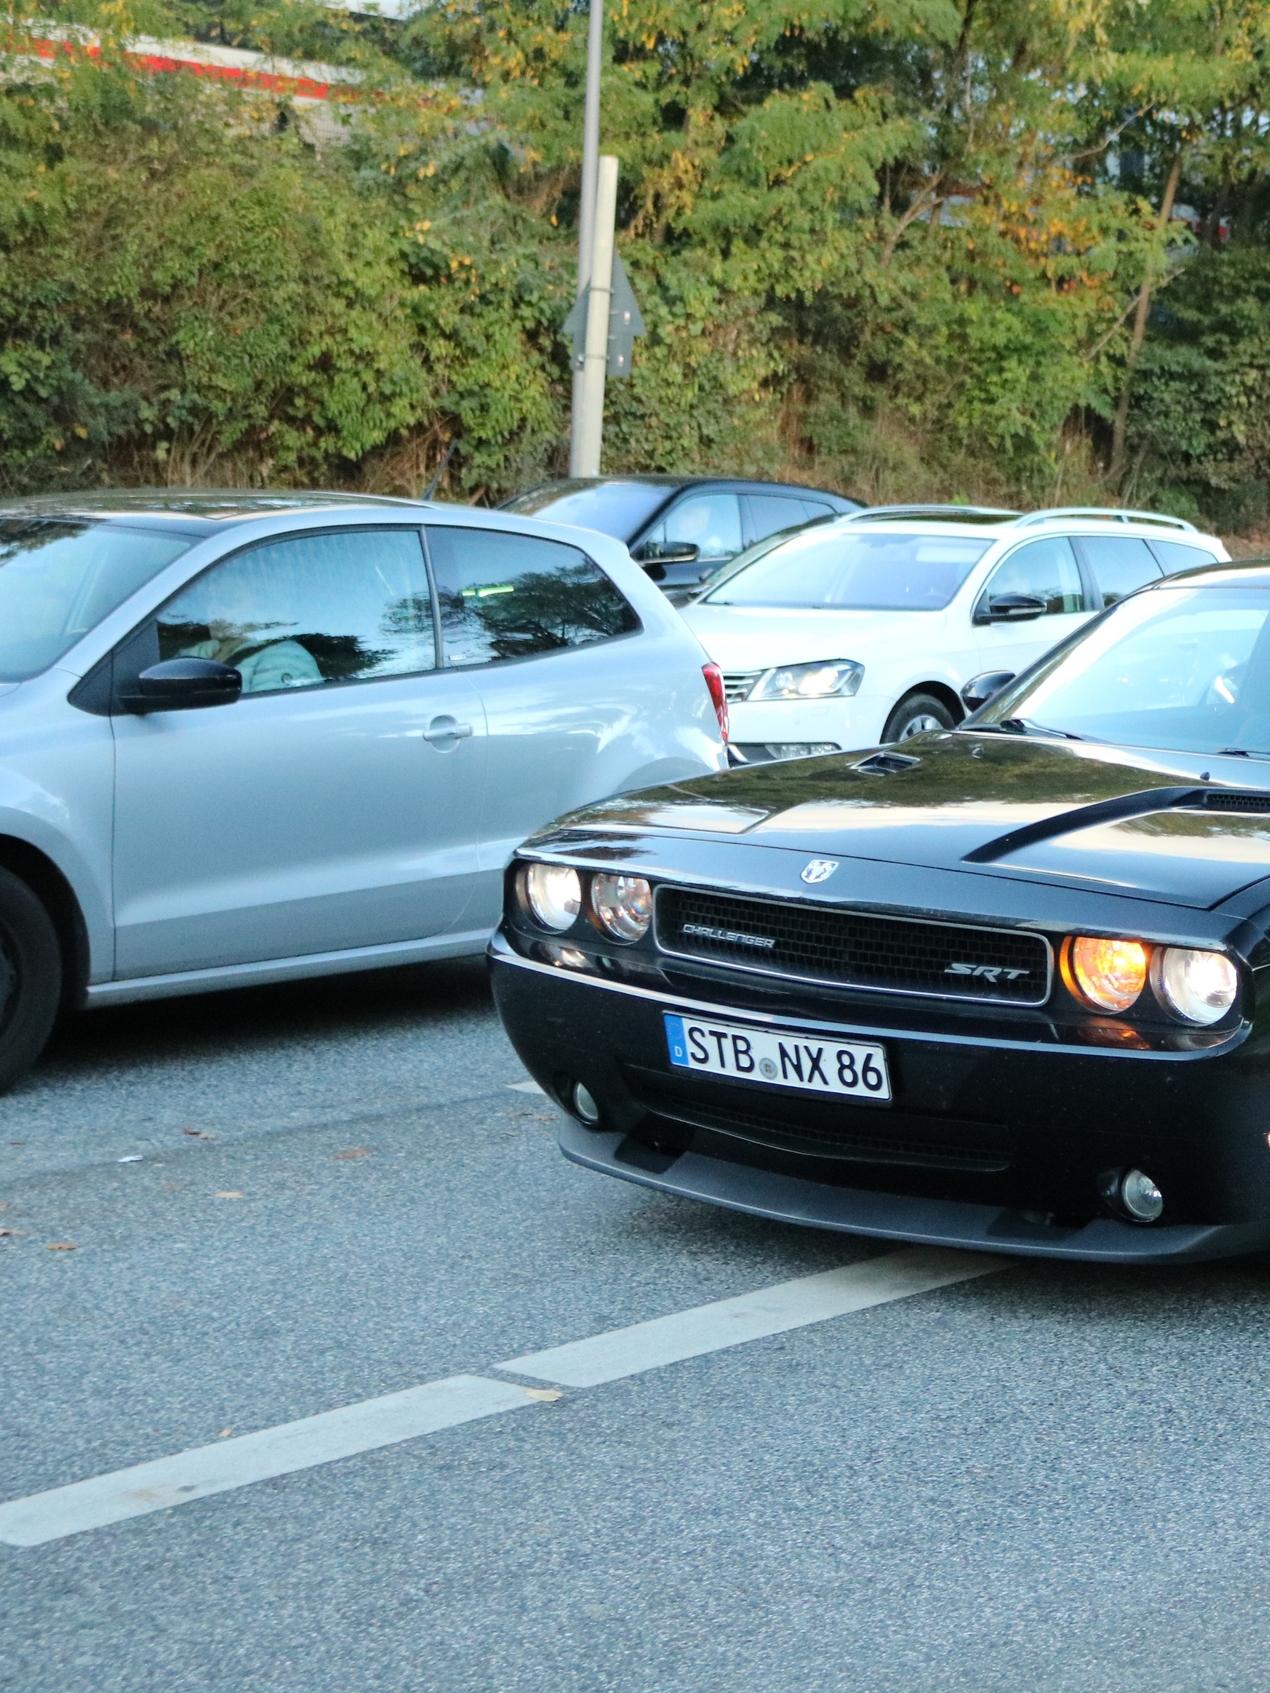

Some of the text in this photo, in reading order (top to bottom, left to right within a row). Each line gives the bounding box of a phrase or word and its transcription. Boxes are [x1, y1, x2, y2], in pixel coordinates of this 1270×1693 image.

[682, 923, 776, 949] CHALLENGER
[944, 963, 1030, 983] SRT
[674, 1046, 683, 1057] D
[687, 1026, 883, 1092] STB NX 86
